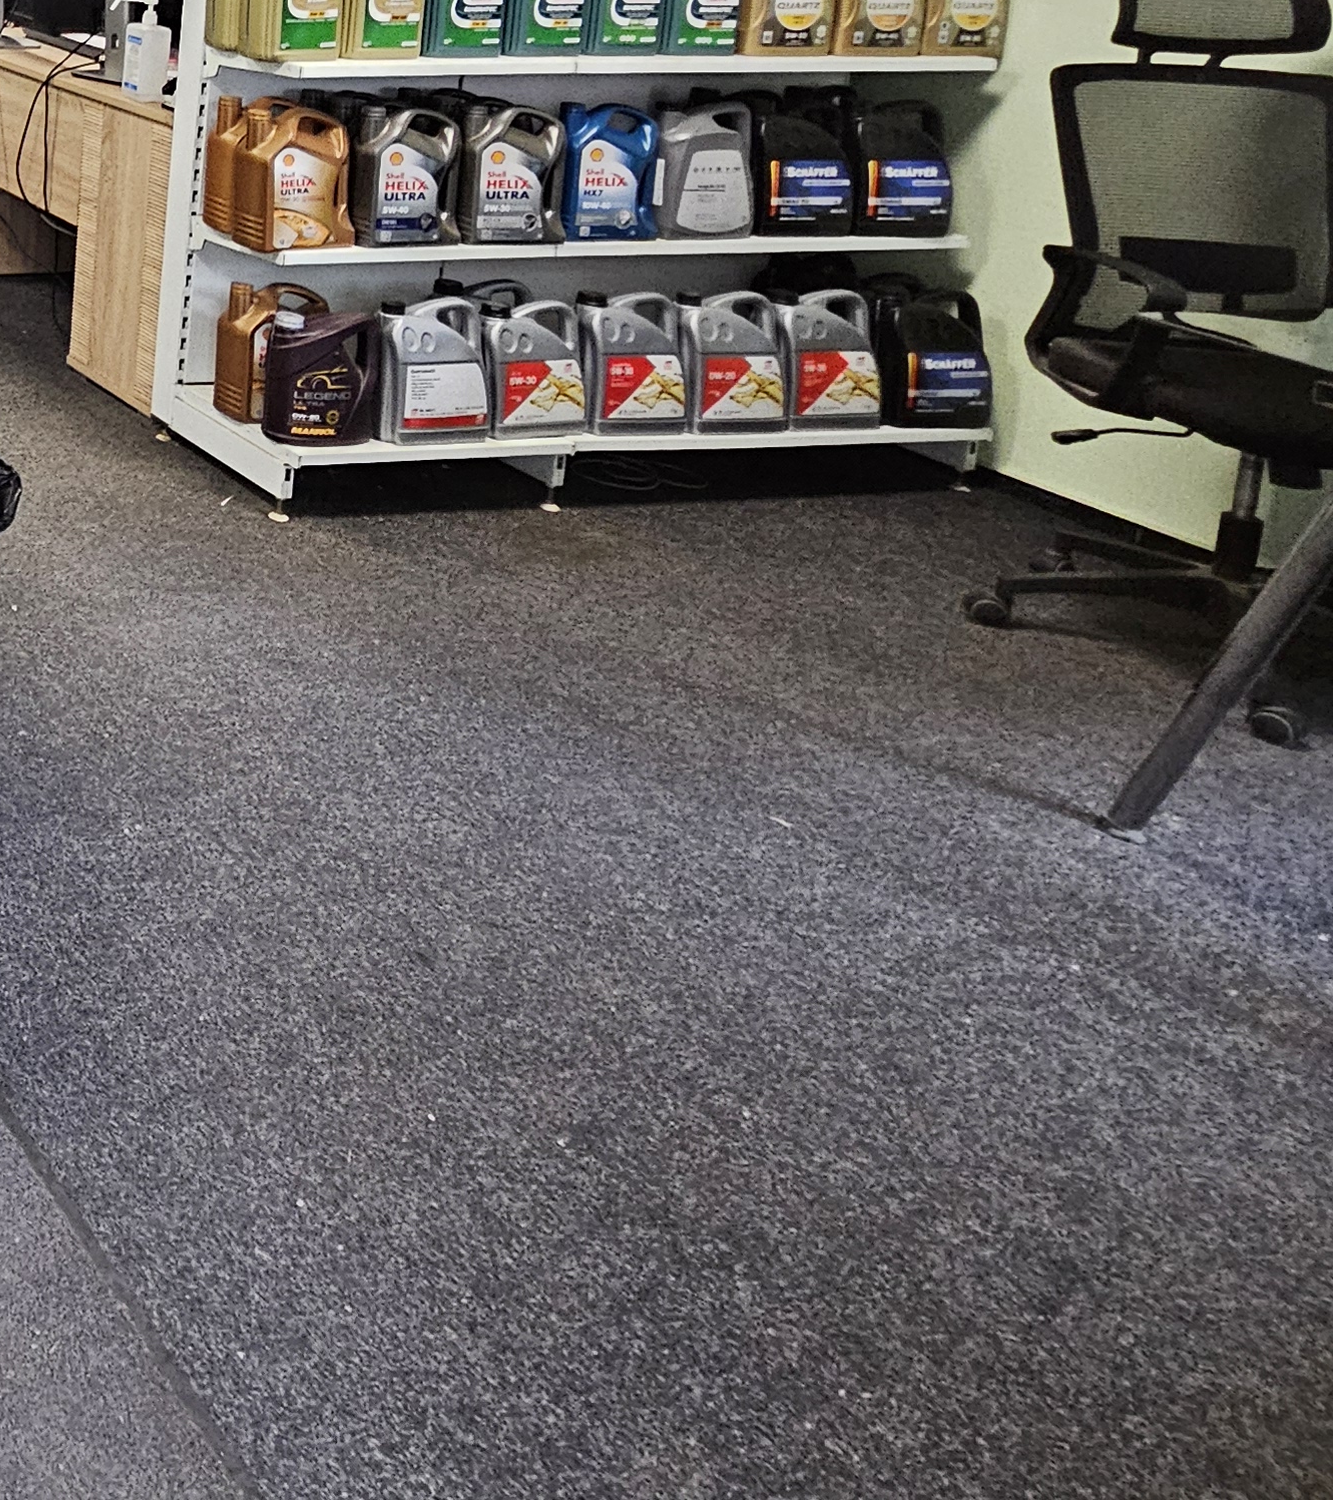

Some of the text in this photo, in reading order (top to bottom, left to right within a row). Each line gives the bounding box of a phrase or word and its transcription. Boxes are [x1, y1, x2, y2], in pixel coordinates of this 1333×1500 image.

[776, 2, 821, 11] QUARTZ
[868, 2, 911, 11] QUARTZ
[953, 2, 995, 10] QUARTZ
[386, 172, 405, 180] Shell
[280, 178, 314, 189] HELIX
[385, 181, 426, 191] HELIX
[486, 179, 529, 189] HELIX
[585, 177, 625, 187] HELIX
[280, 187, 310, 196] ULTRA
[486, 191, 530, 200] ULTRA
[384, 192, 426, 201] ULTRA
[381, 206, 409, 215] 5W-40
[483, 204, 511, 213] 5W-30
[509, 376, 537, 387] 5W-30
[292, 391, 352, 401] LEGEND
[290, 426, 336, 436] MANNOL
